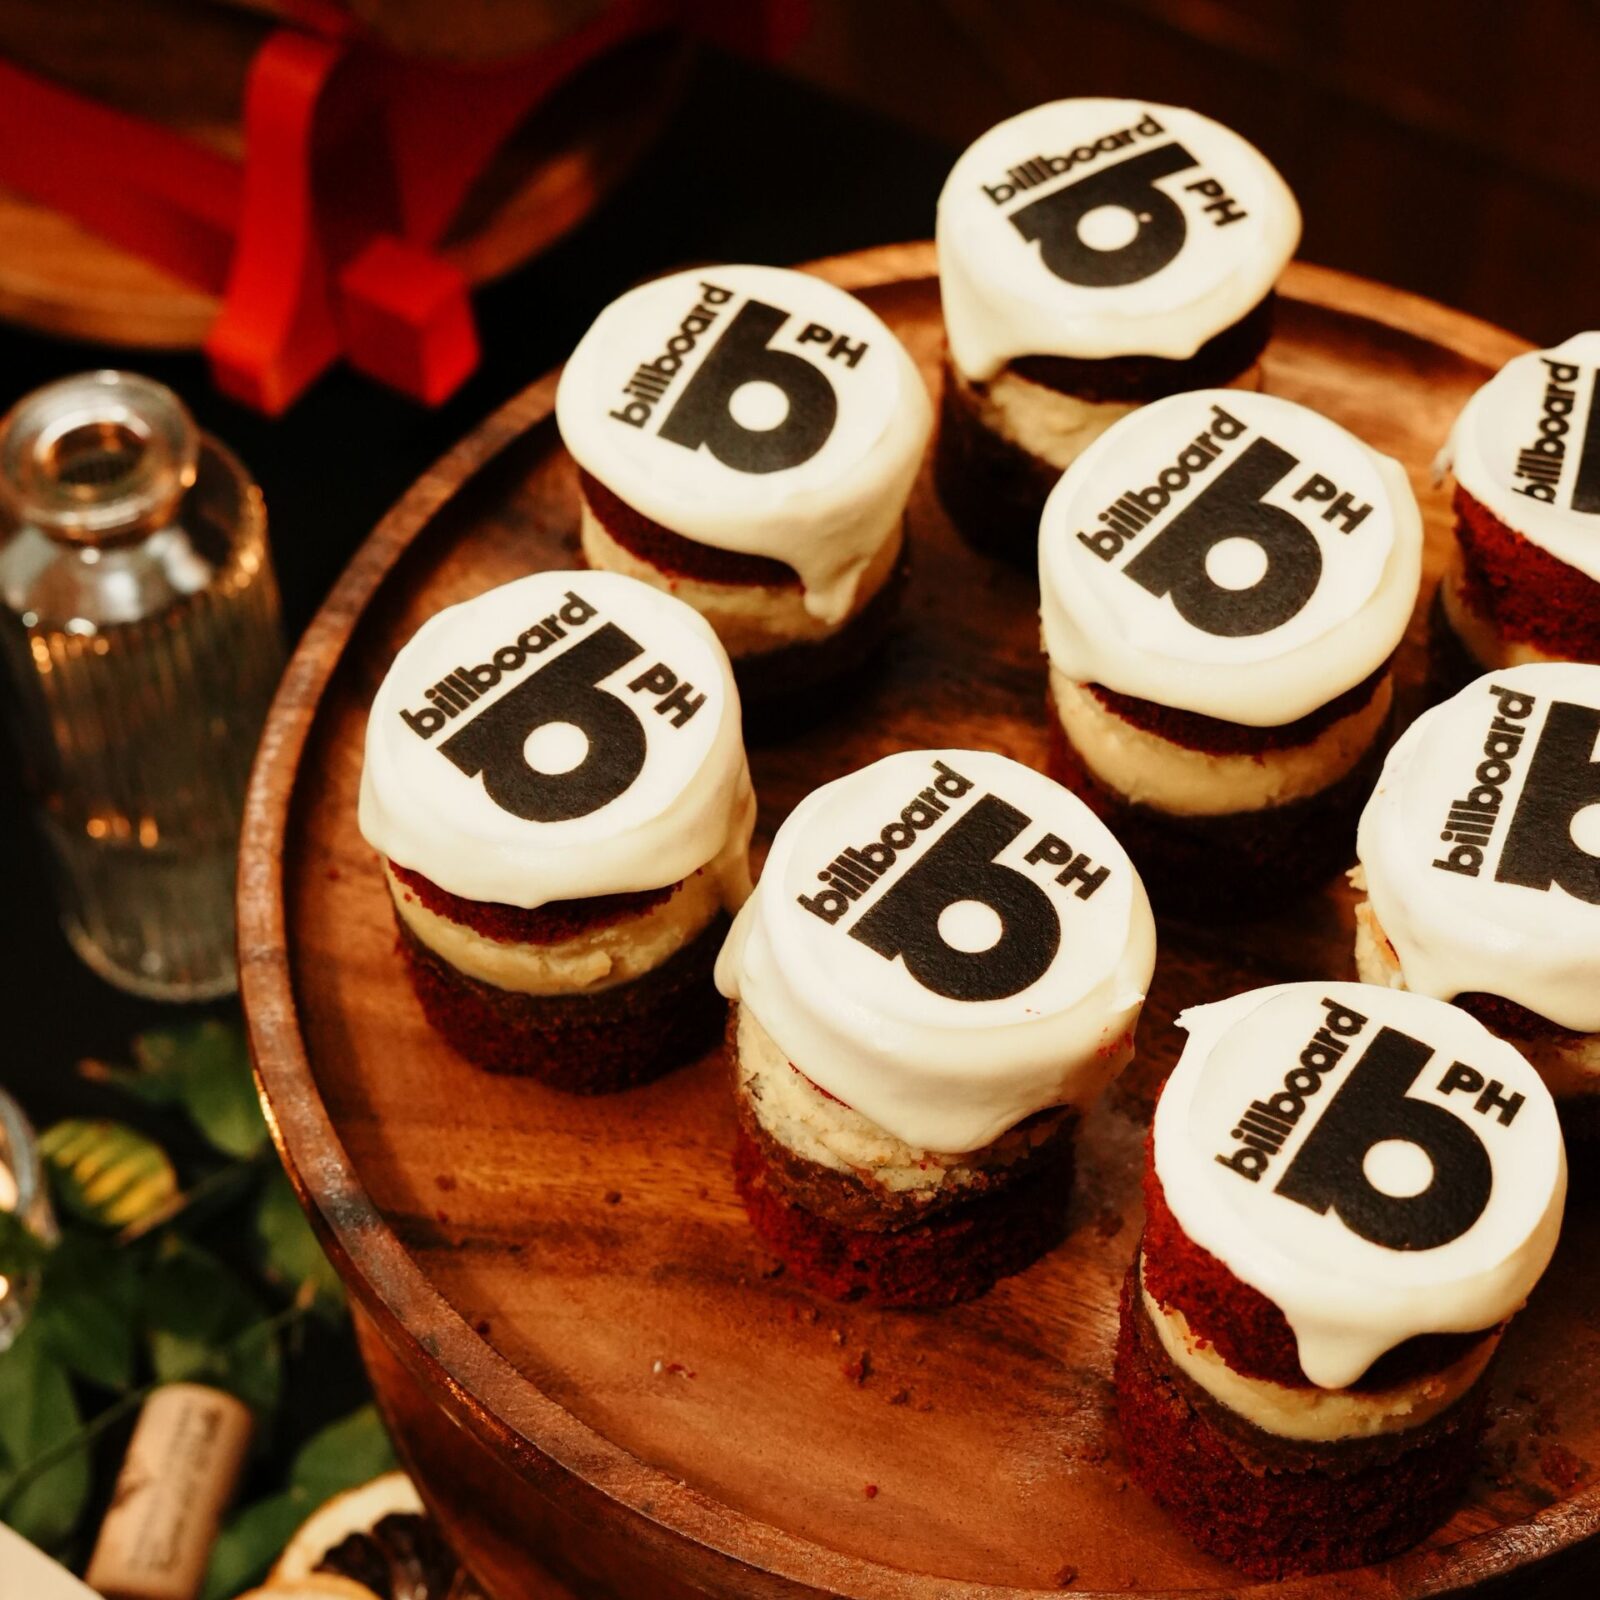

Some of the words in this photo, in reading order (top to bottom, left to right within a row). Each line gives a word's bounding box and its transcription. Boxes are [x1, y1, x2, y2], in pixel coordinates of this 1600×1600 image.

[983, 115, 1164, 205] billboard
[1009, 142, 1199, 287] b
[1185, 179, 1246, 226] PH
[611, 283, 733, 428] billboard
[658, 300, 837, 474] b
[797, 324, 868, 368] PH
[1077, 406, 1247, 561] billboard
[1293, 474, 1372, 534] PH
[1512, 358, 1580, 504] billboard
[1122, 437, 1322, 637] b
[400, 592, 597, 739] billboard
[437, 622, 646, 823] b
[628, 663, 705, 728] PH
[797, 761, 974, 925] billboard
[1433, 685, 1535, 877] billboard
[848, 794, 1061, 1002] b
[1024, 833, 1110, 900] PH
[1216, 998, 1368, 1182] billboard
[1274, 1026, 1493, 1251] b
[1437, 1061, 1525, 1127] PH
